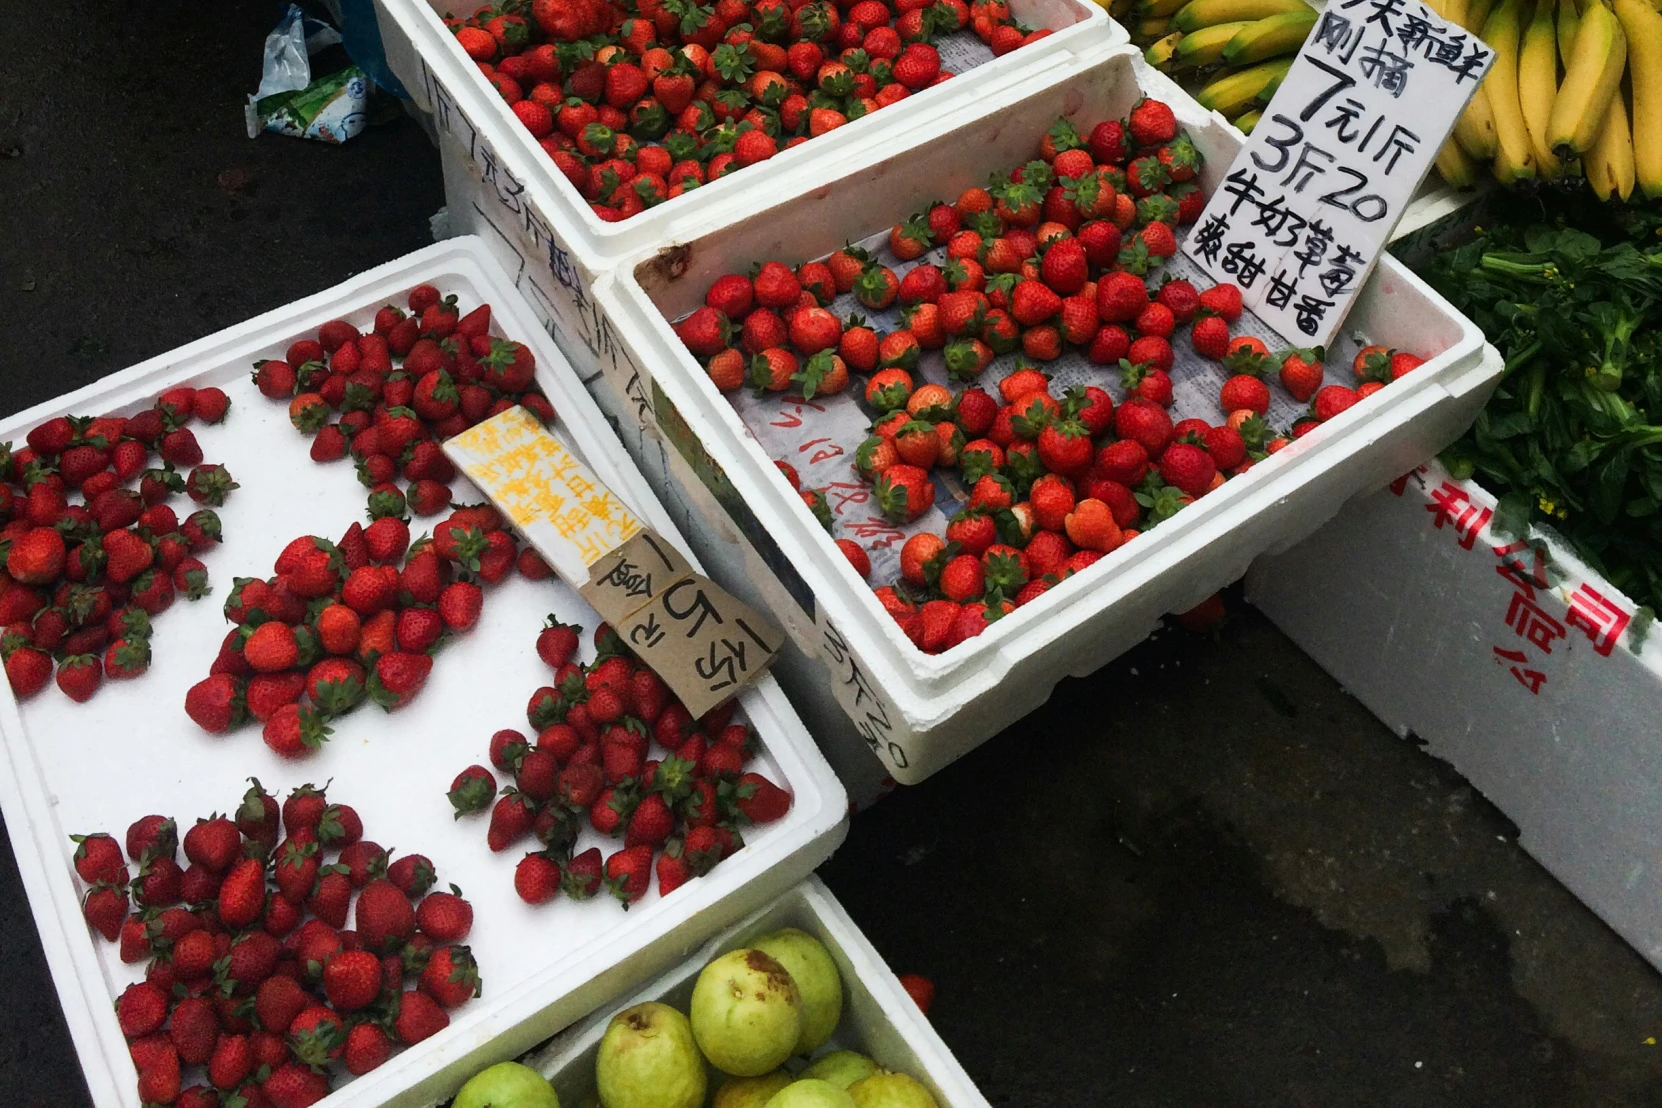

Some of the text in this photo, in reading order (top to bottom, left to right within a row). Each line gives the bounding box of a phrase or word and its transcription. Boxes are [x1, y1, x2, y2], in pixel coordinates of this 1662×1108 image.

[1315, 9, 1415, 98] 刚摘
[1249, 113, 1388, 222] 3斤20
[1300, 53, 1421, 175] 7元1斤
[1193, 212, 1336, 337] 爽甜甘香
[1224, 167, 1366, 298] 牛奶草莓
[596, 533, 674, 597] 1盒
[629, 578, 723, 649] 5元
[1389, 464, 1631, 658] 利公司
[694, 617, 773, 692] 1份
